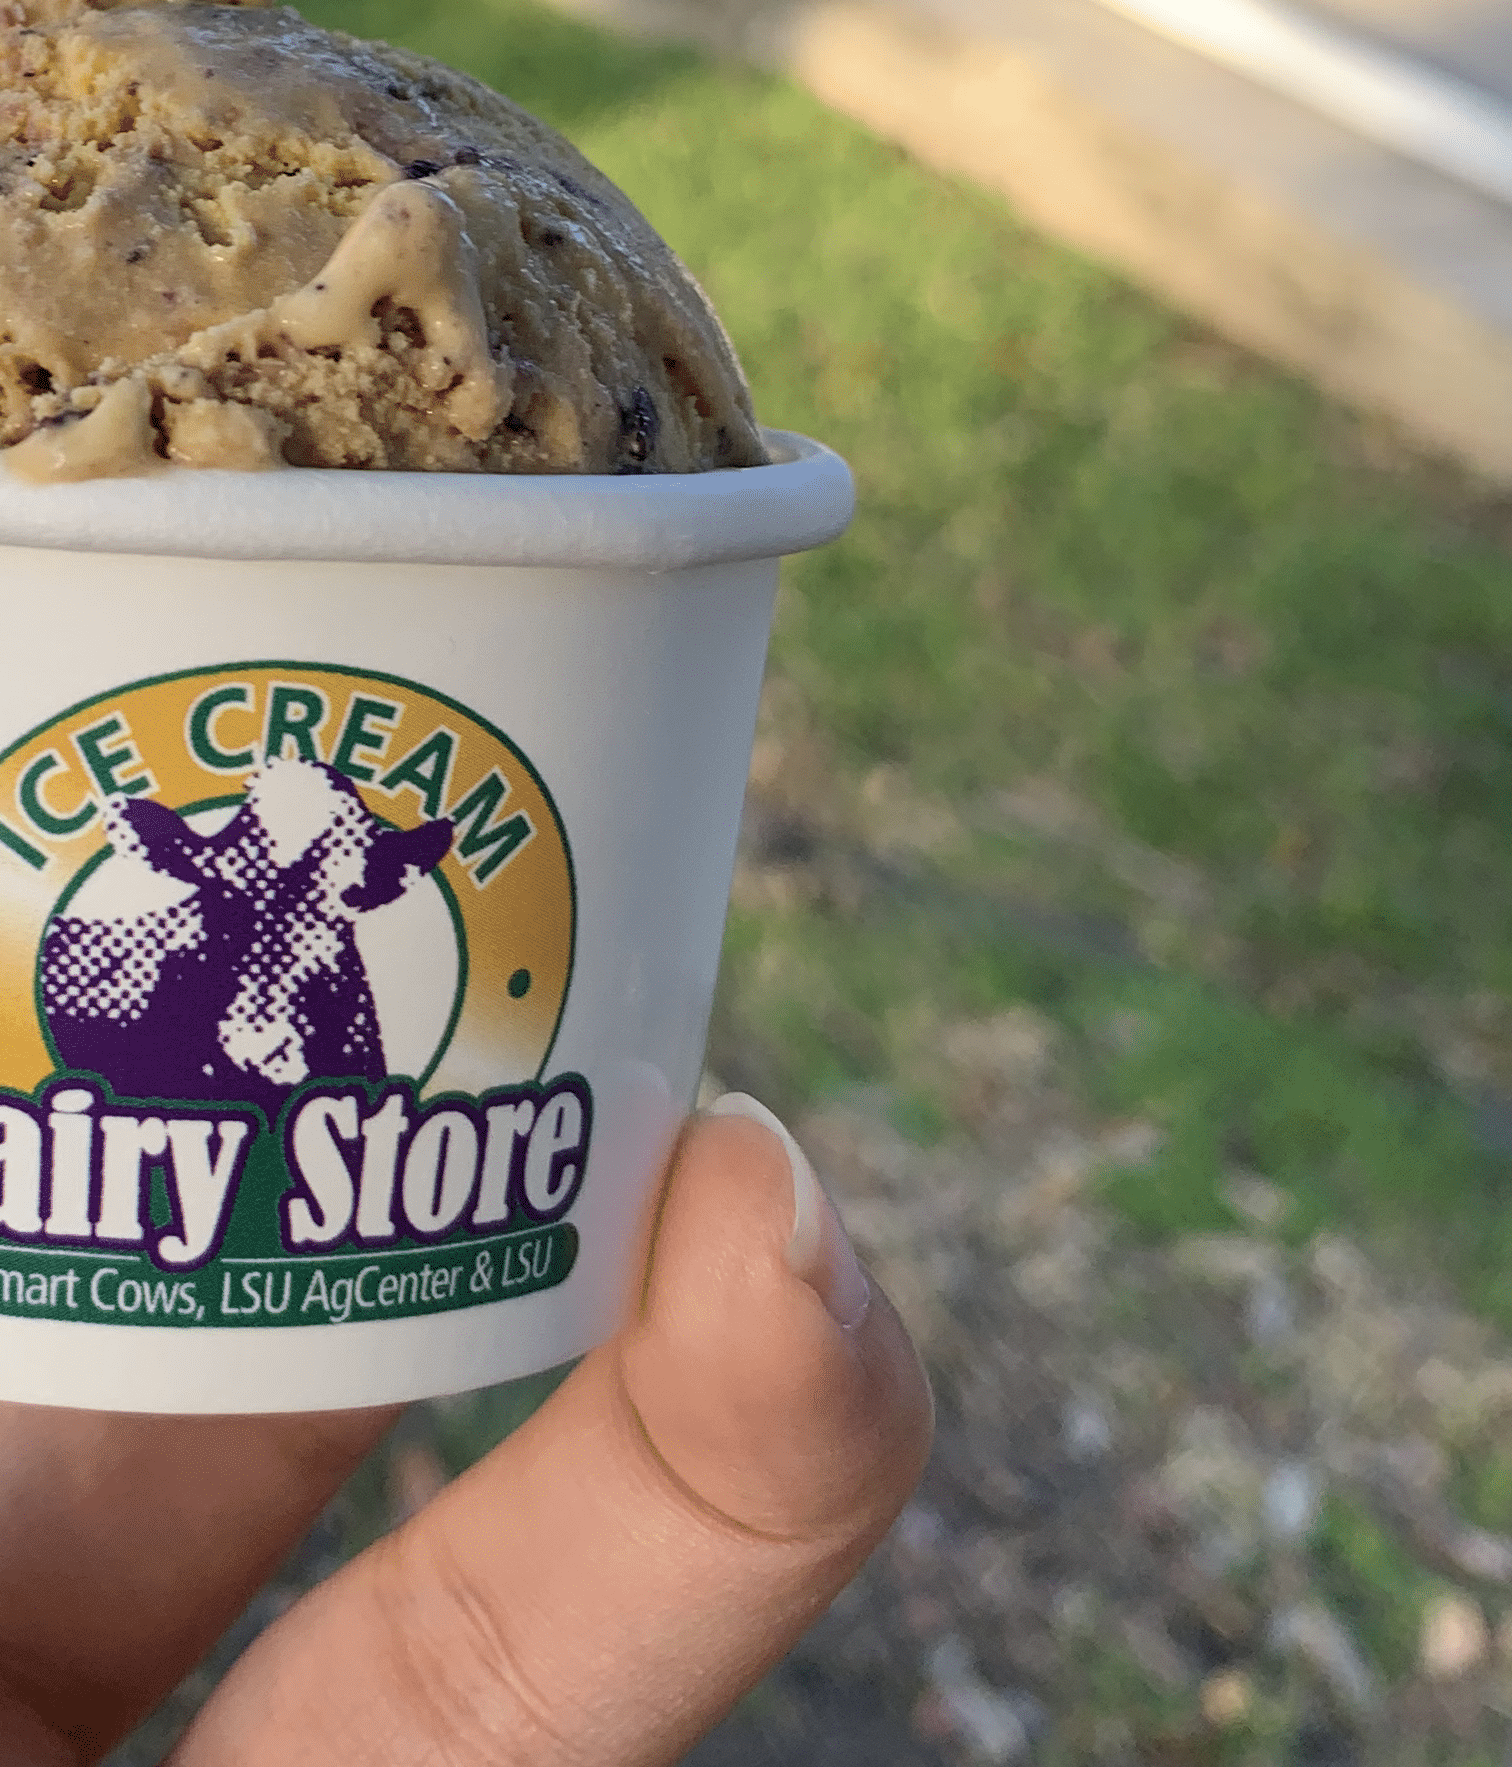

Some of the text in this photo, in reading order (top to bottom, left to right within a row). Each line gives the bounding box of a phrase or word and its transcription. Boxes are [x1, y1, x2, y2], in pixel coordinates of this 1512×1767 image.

[189, 686, 532, 882] CREAM
[289, 1089, 584, 1245] Store
[90, 1267, 205, 1320] Cows,
[221, 1271, 292, 1315] LSU
[300, 1263, 464, 1323] AgCenter
[470, 1250, 494, 1291] &
[501, 1236, 553, 1285] LSU
